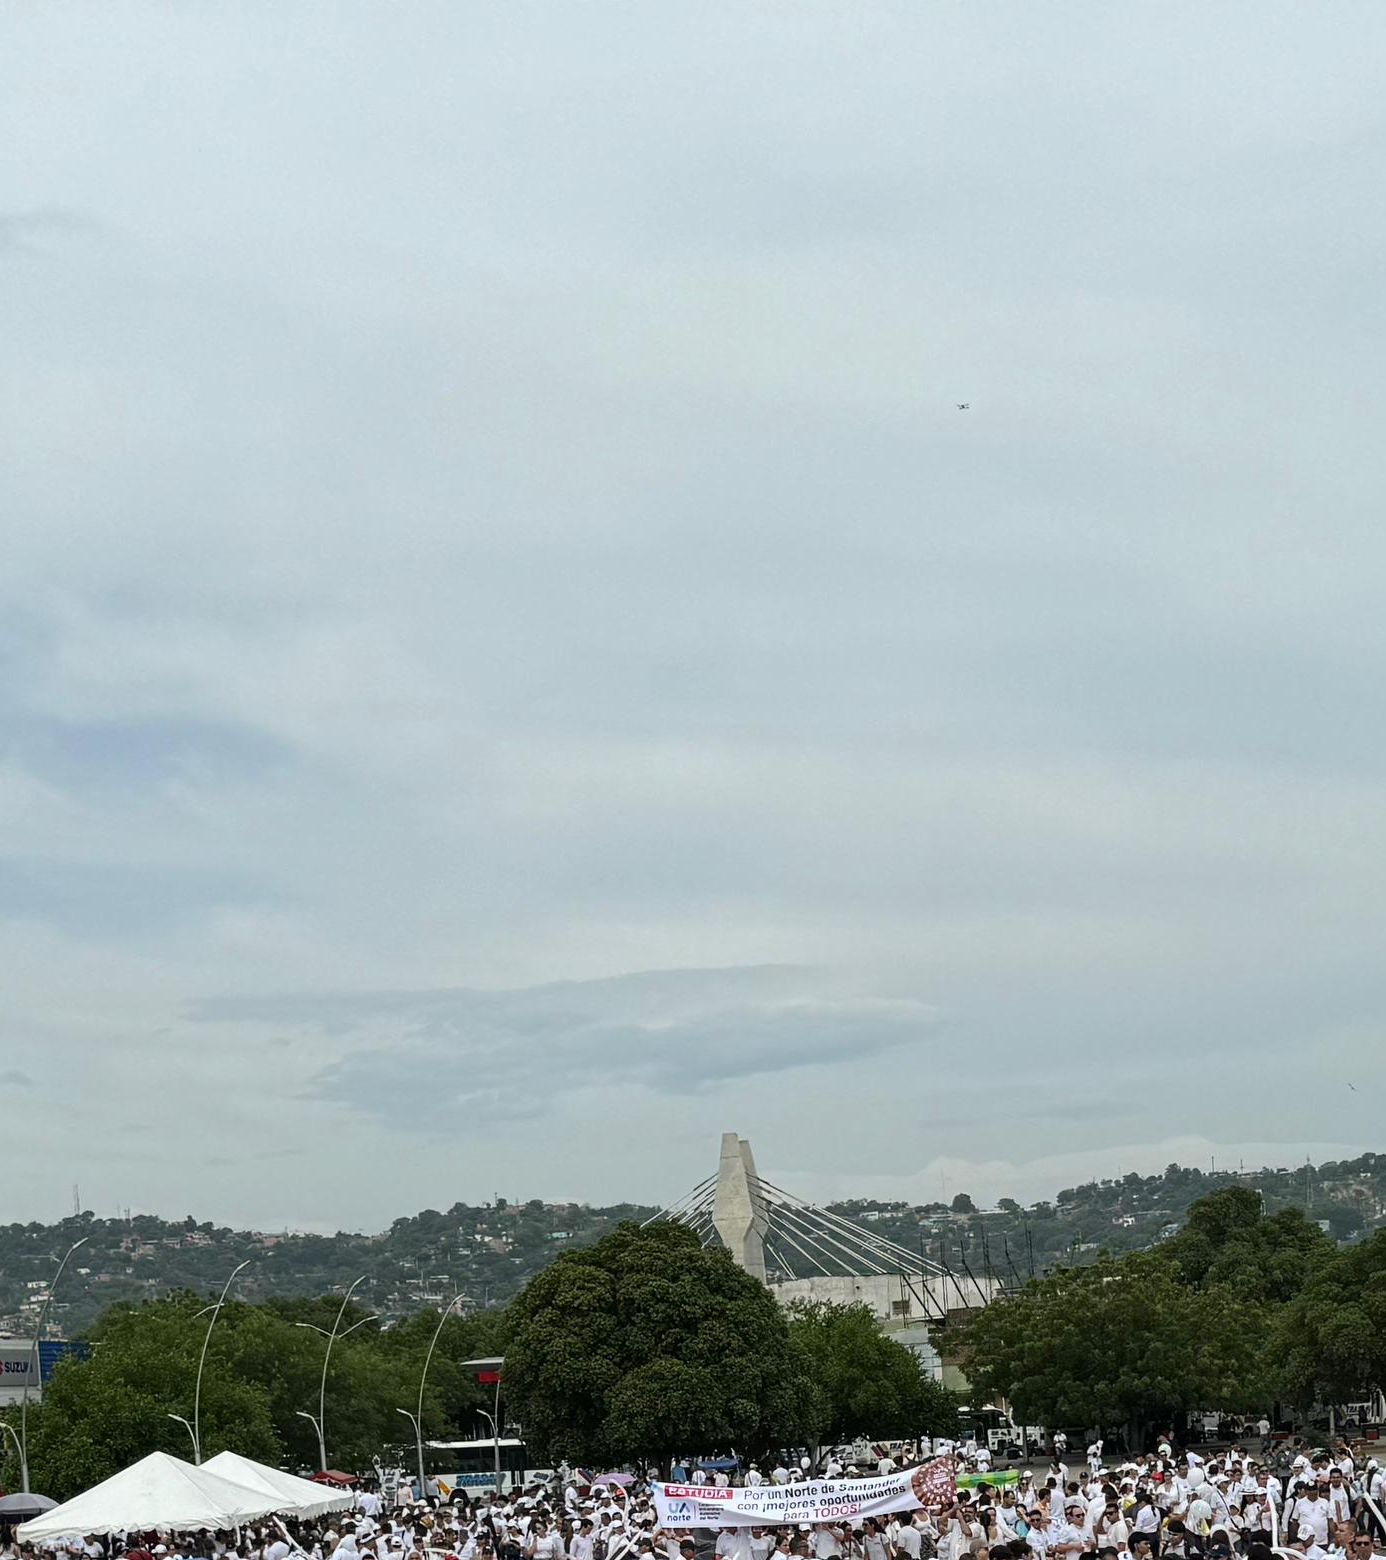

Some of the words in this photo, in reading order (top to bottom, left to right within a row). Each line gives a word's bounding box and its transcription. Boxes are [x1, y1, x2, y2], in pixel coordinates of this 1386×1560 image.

[737, 1502, 759, 1511] con
[820, 1485, 906, 1508] oportunidades
[744, 1490, 764, 1500] Por
[767, 1490, 783, 1499] un
[785, 1486, 818, 1499] Norte
[821, 1483, 835, 1494] de
[838, 1476, 901, 1492] Santander
[666, 1513, 691, 1522] norte
[783, 1511, 810, 1522] para
[813, 1503, 862, 1519] TODOS!
